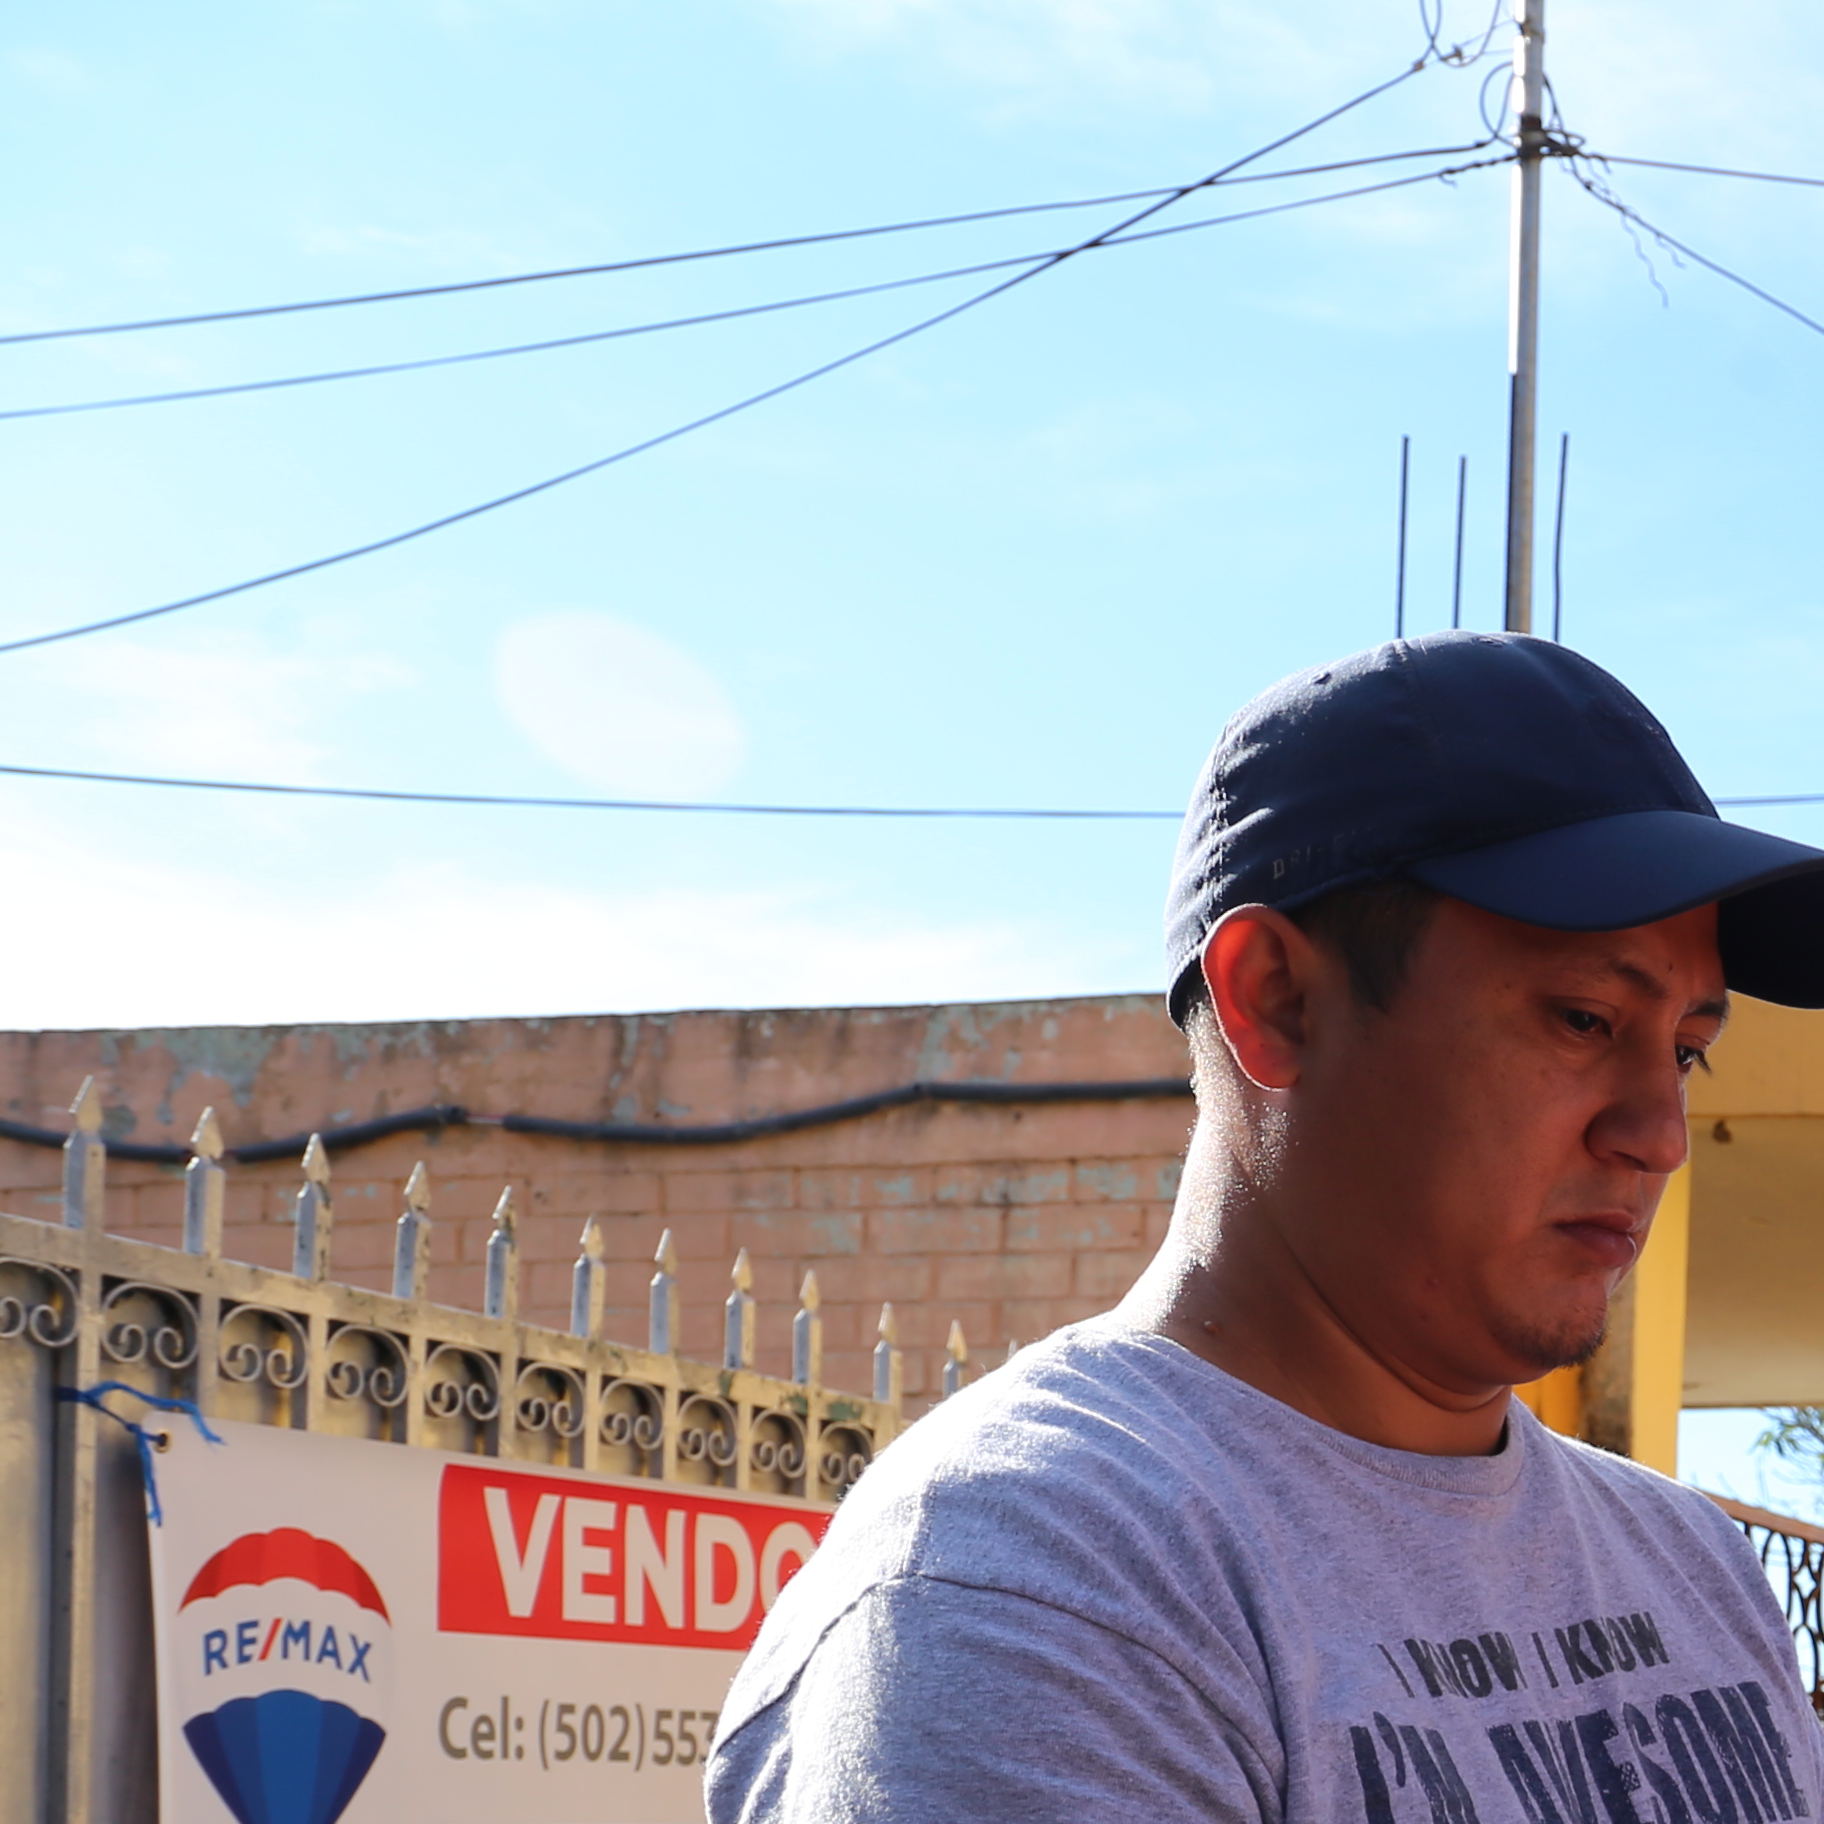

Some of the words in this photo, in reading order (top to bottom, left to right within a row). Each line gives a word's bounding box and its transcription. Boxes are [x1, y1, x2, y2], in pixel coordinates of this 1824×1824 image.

[203, 1617, 372, 1683] RE/MAX
[1532, 1632, 1559, 1688] I
[1555, 1611, 1670, 1685] KNOW
[438, 1695, 525, 1760] Cel:
